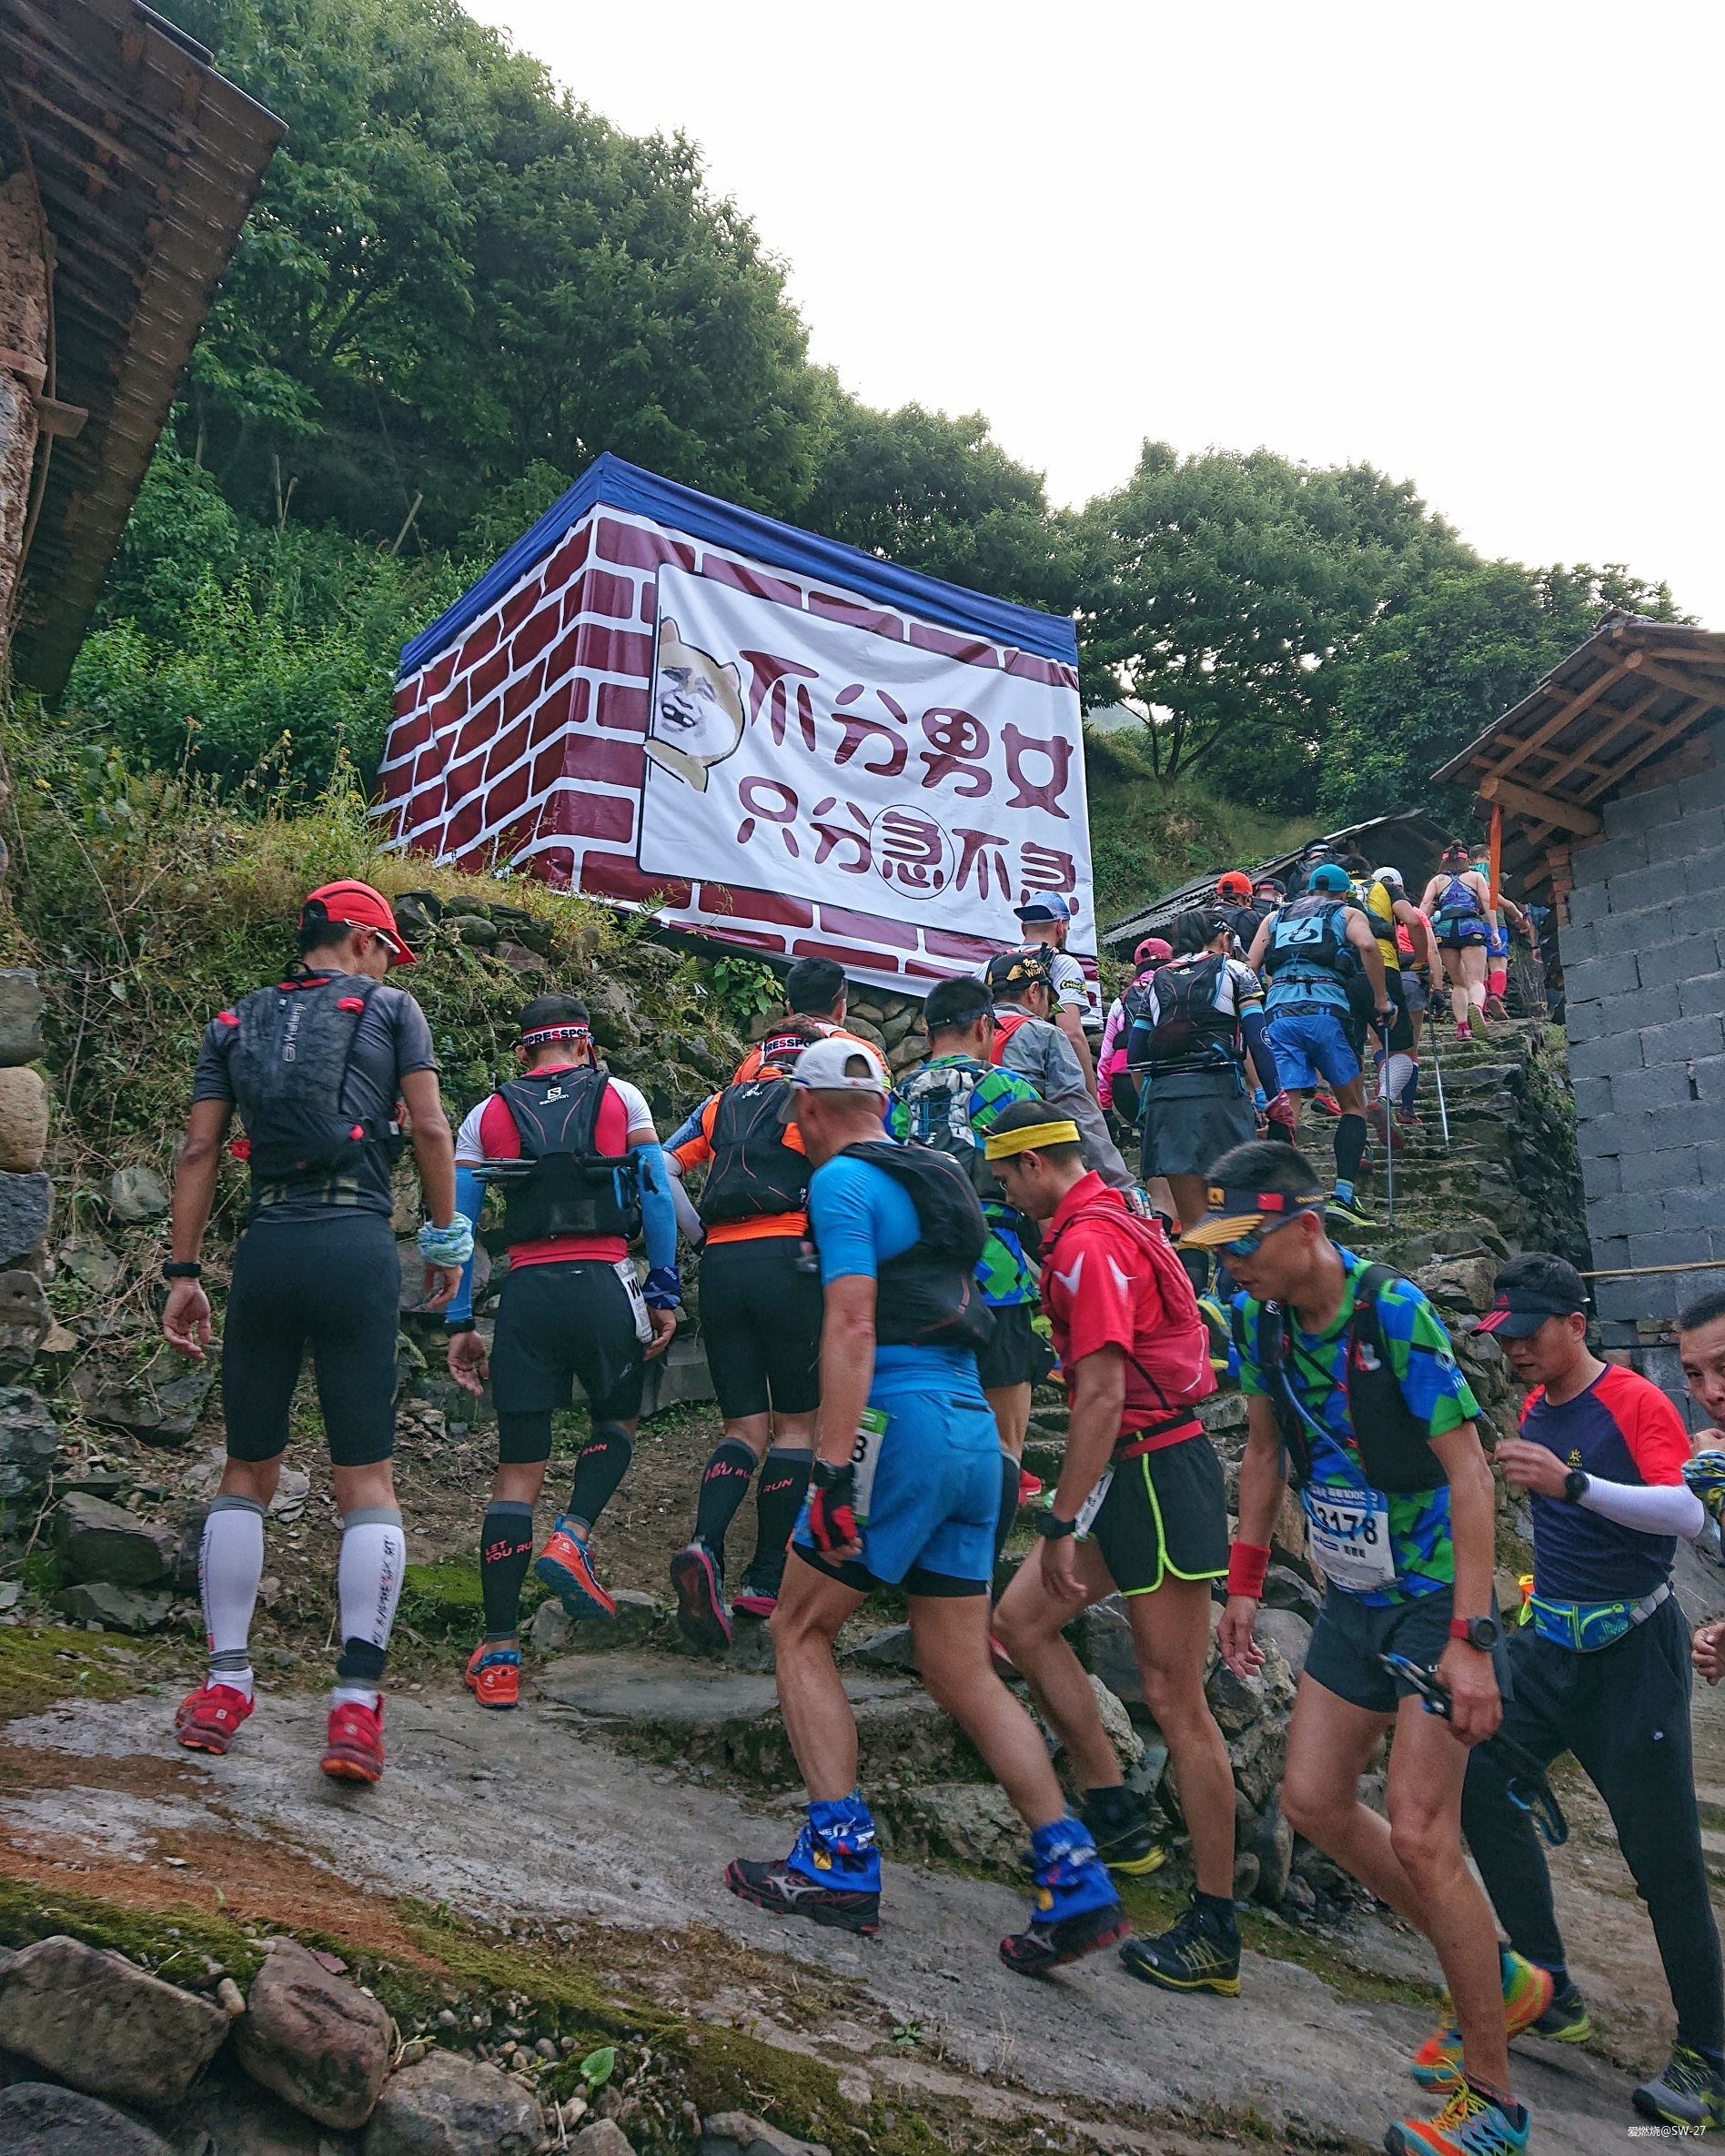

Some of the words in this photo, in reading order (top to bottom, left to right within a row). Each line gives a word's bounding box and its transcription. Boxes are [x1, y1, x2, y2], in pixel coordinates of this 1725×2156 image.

[738, 650, 1074, 820] 不分男女
[736, 775, 1081, 916] 只分急不急
[485, 1540, 507, 1557] LET
[486, 1547, 513, 1564] YOU
